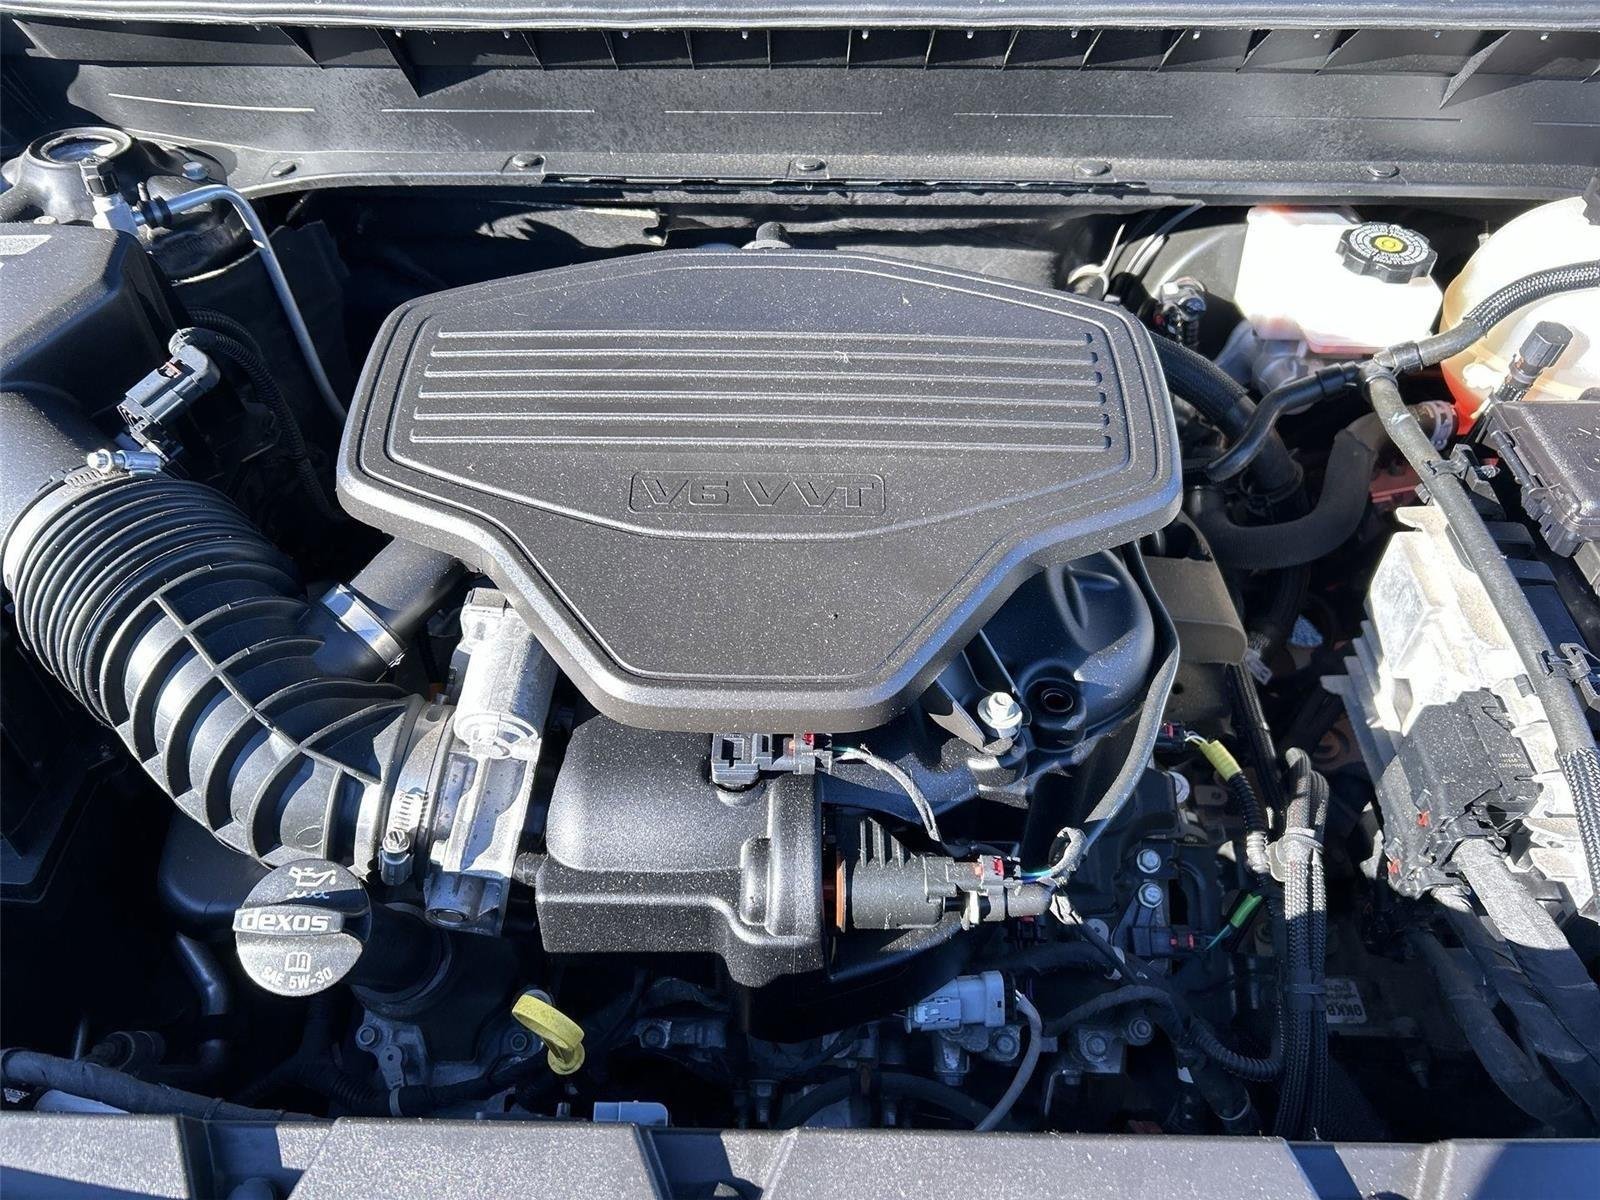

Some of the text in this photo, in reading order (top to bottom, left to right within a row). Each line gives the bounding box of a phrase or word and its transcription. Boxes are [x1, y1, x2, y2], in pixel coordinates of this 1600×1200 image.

[641, 479, 875, 508] V6 VVT
[241, 909, 331, 931] dexos
[289, 967, 333, 989] 5W-30
